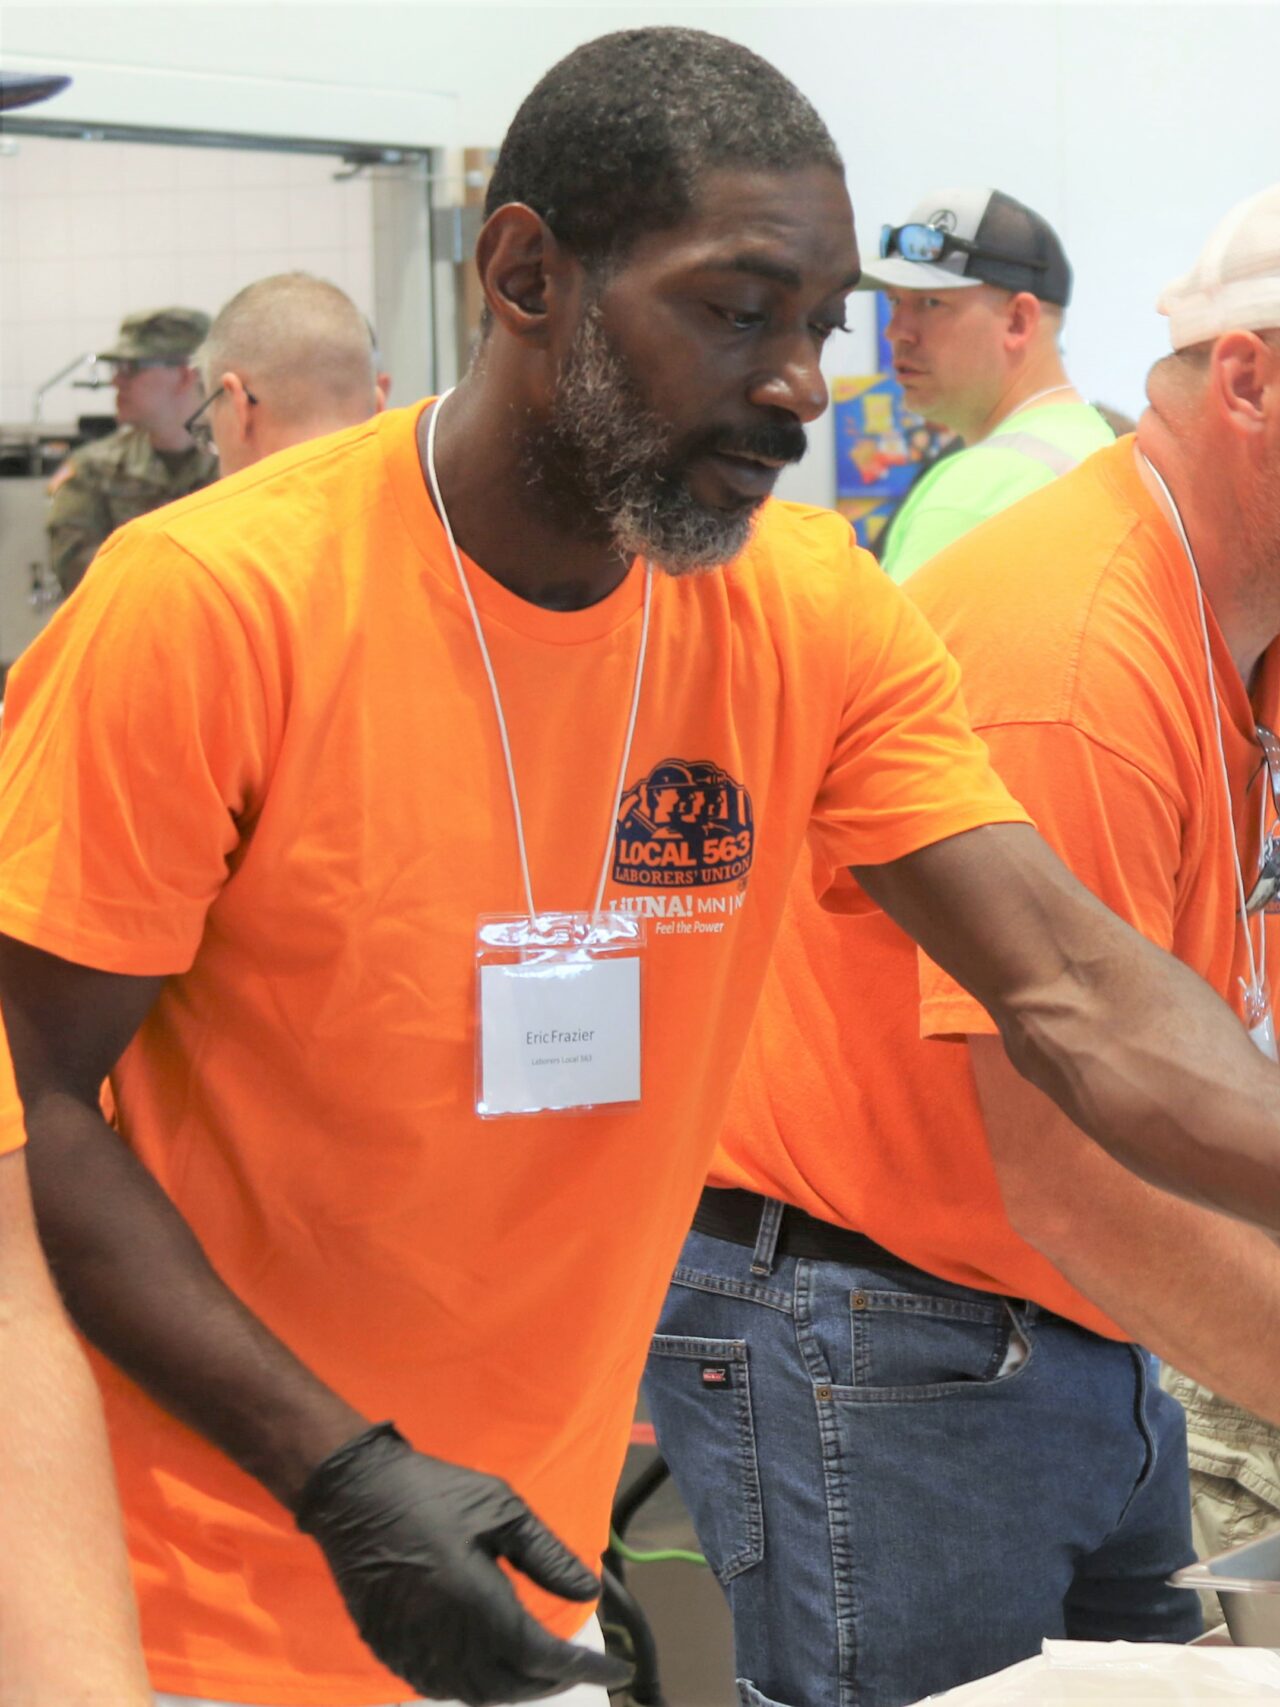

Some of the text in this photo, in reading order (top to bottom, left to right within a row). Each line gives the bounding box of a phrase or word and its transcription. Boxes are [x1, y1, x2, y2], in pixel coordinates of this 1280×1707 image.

[619, 830, 751, 867] LOCAL 563
[615, 858, 751, 885] LABORERS' UNION
[698, 897, 725, 913] MN
[655, 921, 724, 934] Feel the Power
[526, 1028, 595, 1045] Eric Frazier
